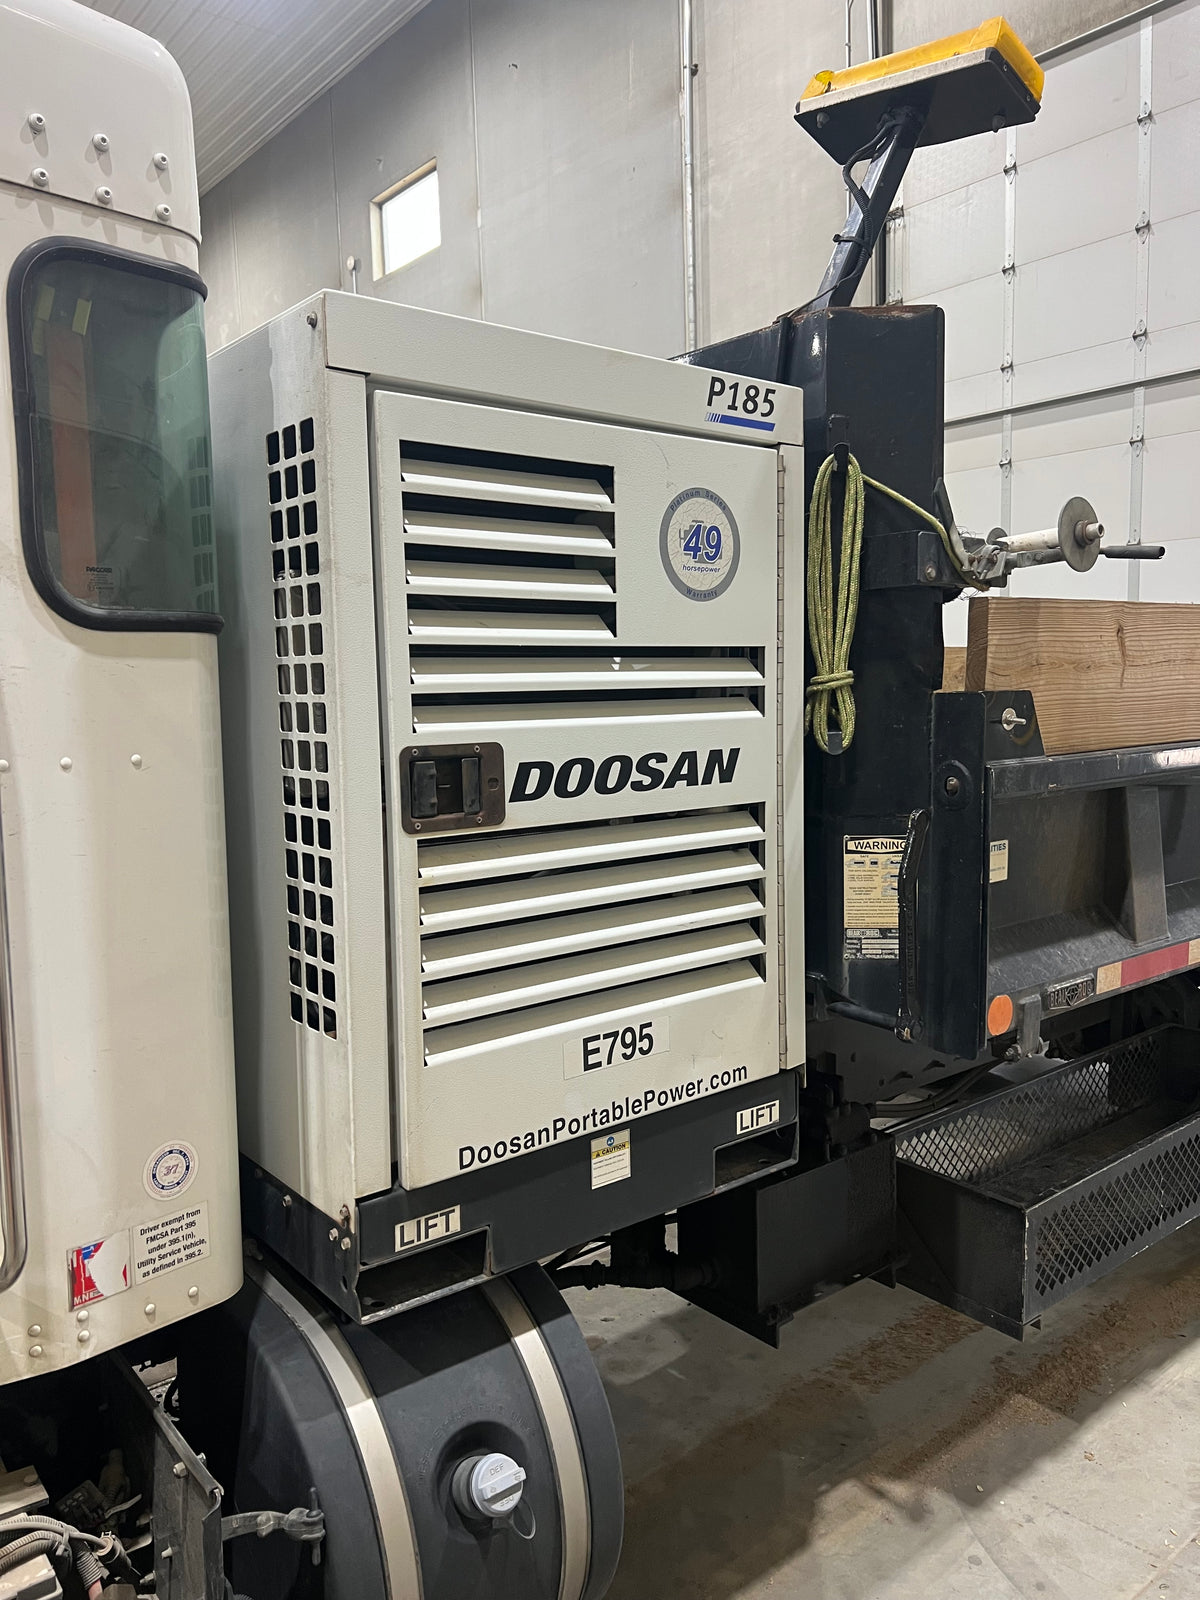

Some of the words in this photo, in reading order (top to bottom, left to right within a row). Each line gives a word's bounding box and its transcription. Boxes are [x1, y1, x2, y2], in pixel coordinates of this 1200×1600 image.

[707, 376, 776, 417] P185
[670, 490, 701, 512] Platinum
[682, 522, 722, 562] 49
[682, 564, 721, 573] horsepower
[686, 587, 718, 599] Warranty
[509, 748, 740, 803] DOOSAN
[583, 1022, 653, 1072] E795
[459, 1065, 748, 1171] DoosanPortablePower.com
[740, 1102, 776, 1131] LIFT
[601, 1143, 626, 1155] CAUTION
[140, 1224, 159, 1236] Driver
[161, 1214, 185, 1228] exempt
[186, 1209, 200, 1218] from
[146, 1231, 169, 1244] FMCSA
[170, 1225, 184, 1235] Part
[185, 1220, 196, 1229] 395
[400, 1208, 455, 1248] LIFT
[137, 1257, 156, 1269] Utility
[158, 1248, 181, 1261] Service
[148, 1242, 167, 1254] under
[142, 1270, 150, 1278] as
[152, 1260, 176, 1274] defined
[490, 1463, 504, 1476] DEF
